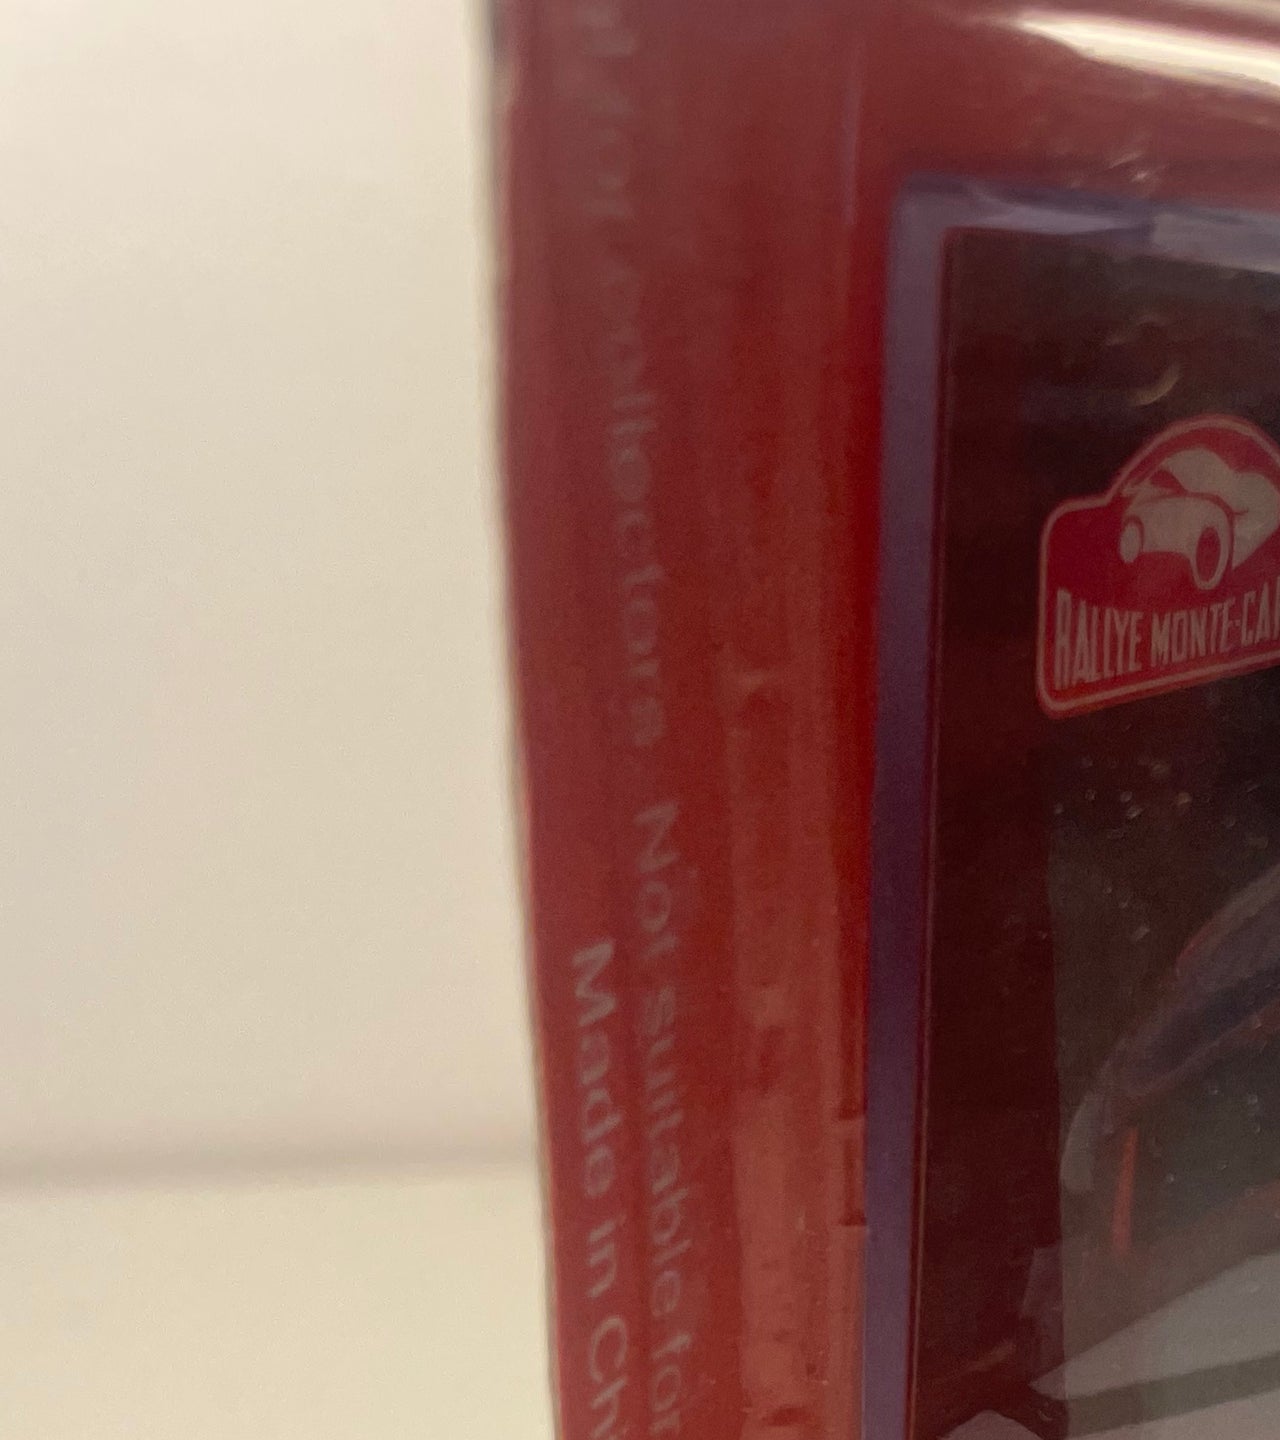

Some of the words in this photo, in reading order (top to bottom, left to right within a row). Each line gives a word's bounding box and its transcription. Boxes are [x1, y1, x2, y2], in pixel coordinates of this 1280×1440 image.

[1054, 586, 1144, 690] RALLYE
[634, 801, 679, 960] Not
[572, 938, 623, 1198] Made
[640, 985, 693, 1318] suitable
[588, 1212, 627, 1299] in
[651, 1333, 692, 1436] for
